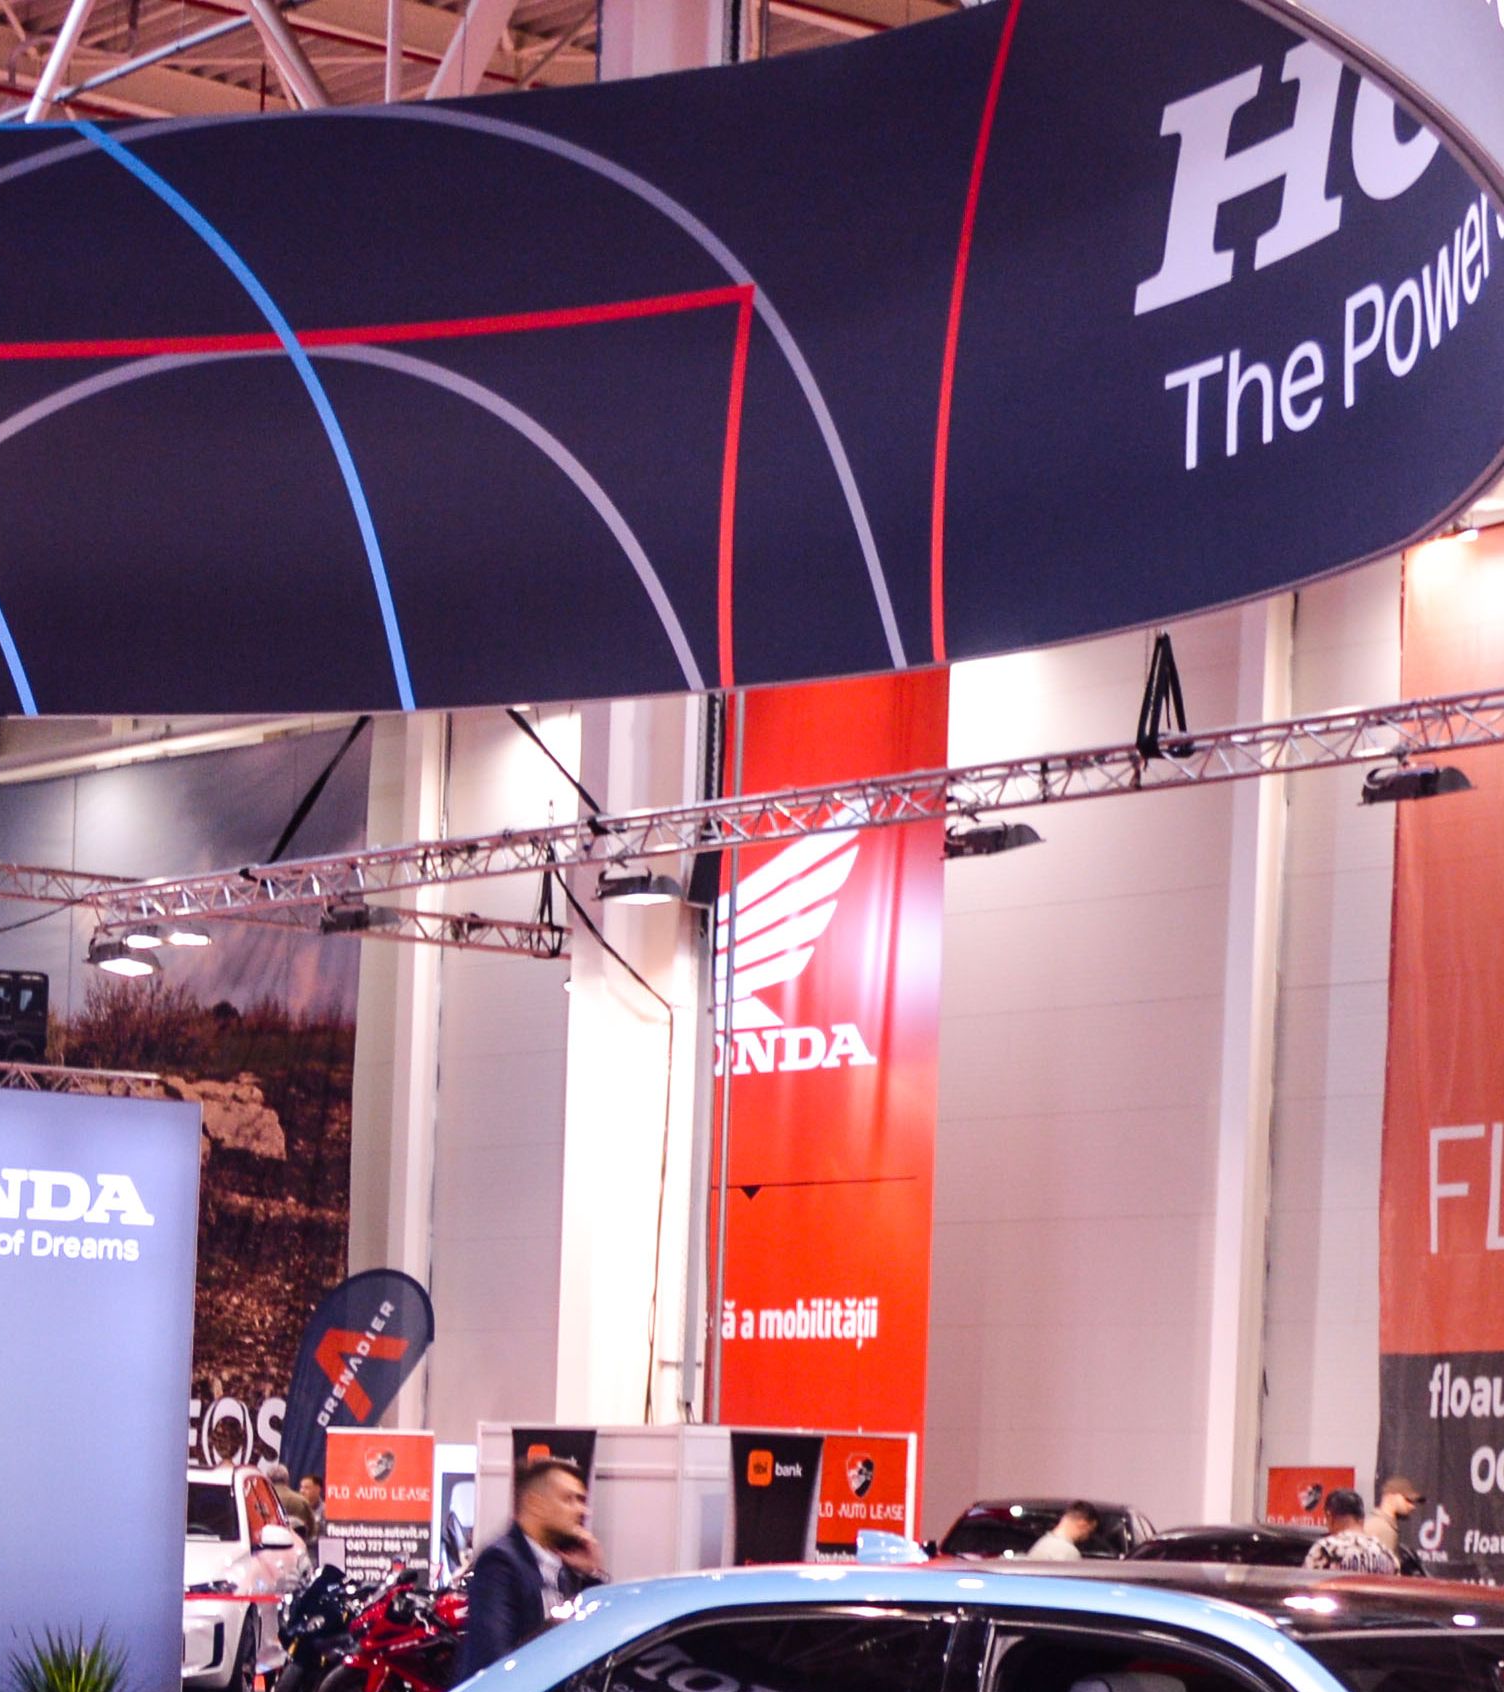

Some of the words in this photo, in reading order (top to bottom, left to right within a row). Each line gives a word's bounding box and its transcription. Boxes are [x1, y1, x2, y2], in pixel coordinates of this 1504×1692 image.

[1164, 332, 1325, 471] The
[31, 1230, 141, 1262] Dreams
[740, 1308, 755, 1340] a
[316, 1299, 395, 1427] GRENADIER
[774, 1462, 803, 1478] bank
[327, 1485, 351, 1500] FLO
[391, 1487, 430, 1501] LEASE
[869, 1503, 905, 1521] LEASE
